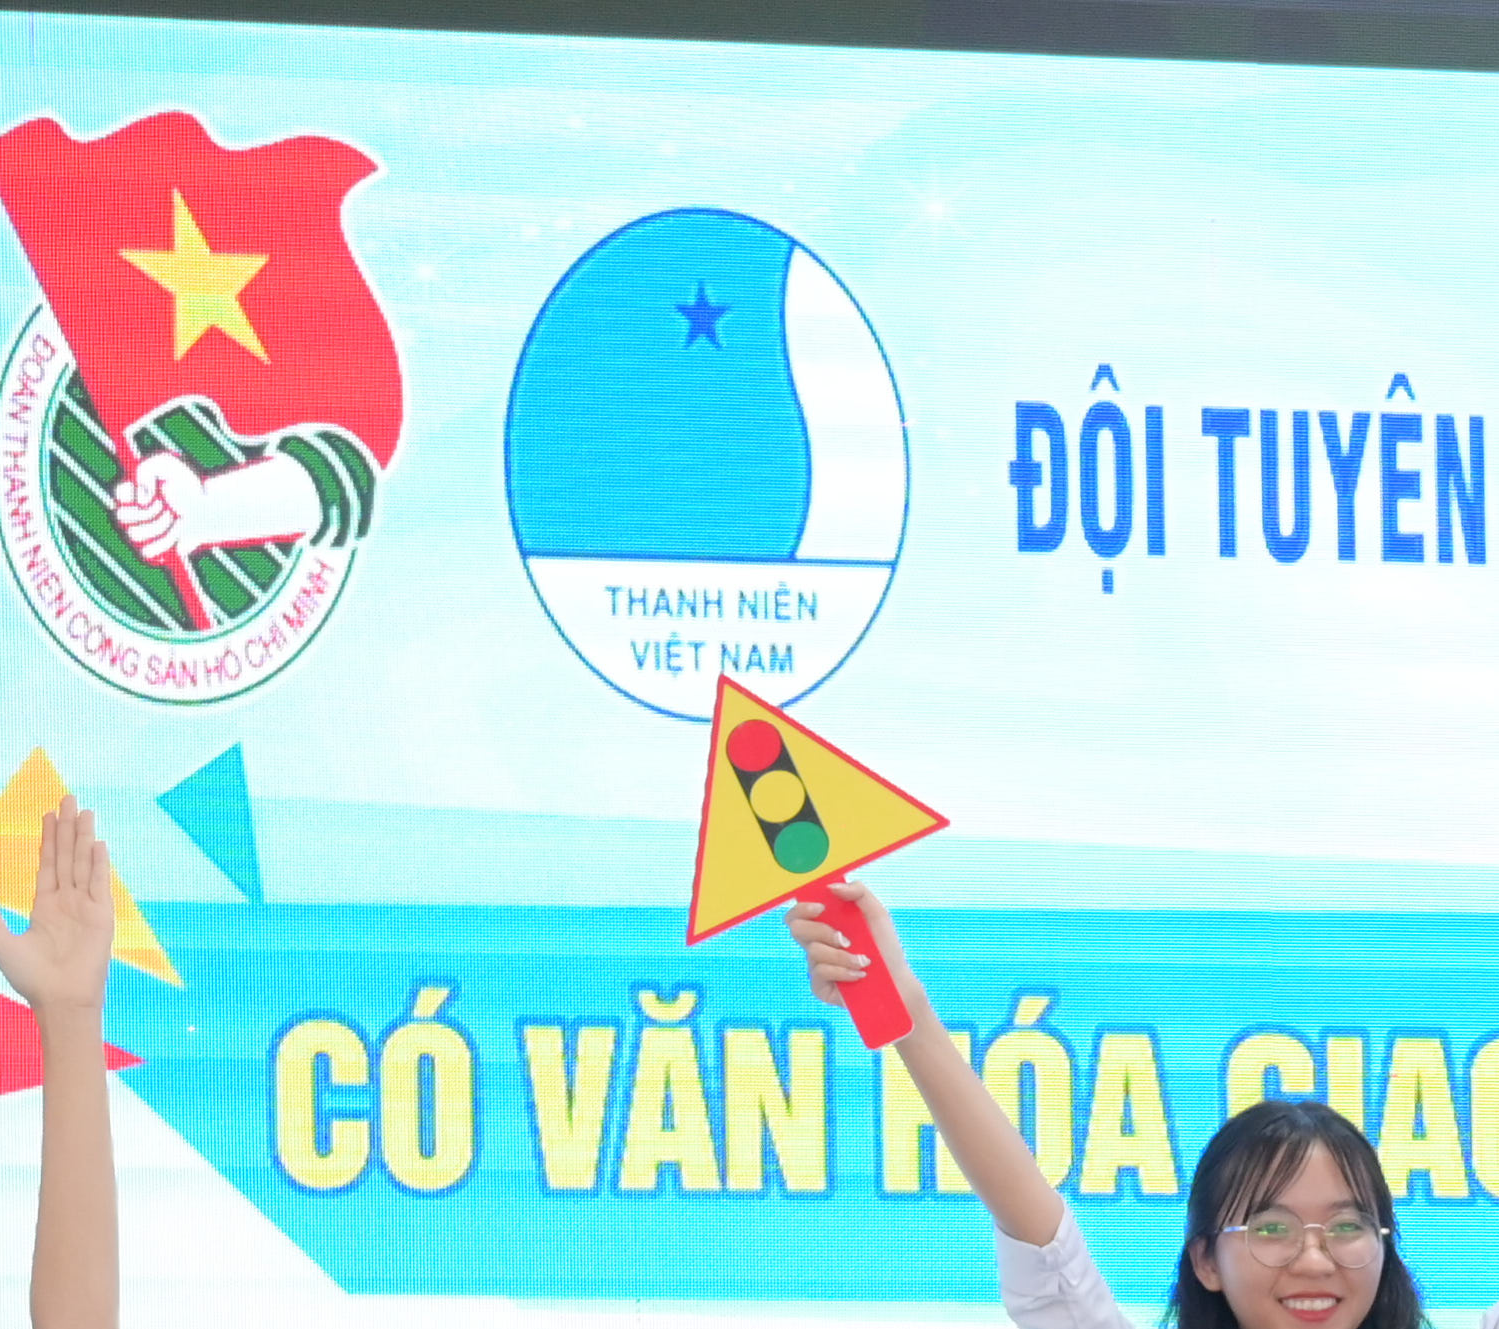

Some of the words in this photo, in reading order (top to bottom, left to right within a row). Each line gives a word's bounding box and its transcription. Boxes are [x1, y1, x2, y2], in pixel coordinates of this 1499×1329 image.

[1008, 363, 1168, 595] ĐỘI
[1200, 372, 1488, 567] TUYÊN
[604, 585, 724, 619] THANH
[738, 580, 819, 621] NIÊN
[630, 631, 707, 679] VIỆT
[720, 641, 794, 673] NAM
[275, 985, 475, 1192] CÓ
[522, 990, 828, 1193] VĂN
[878, 994, 1181, 1197] HÓA
